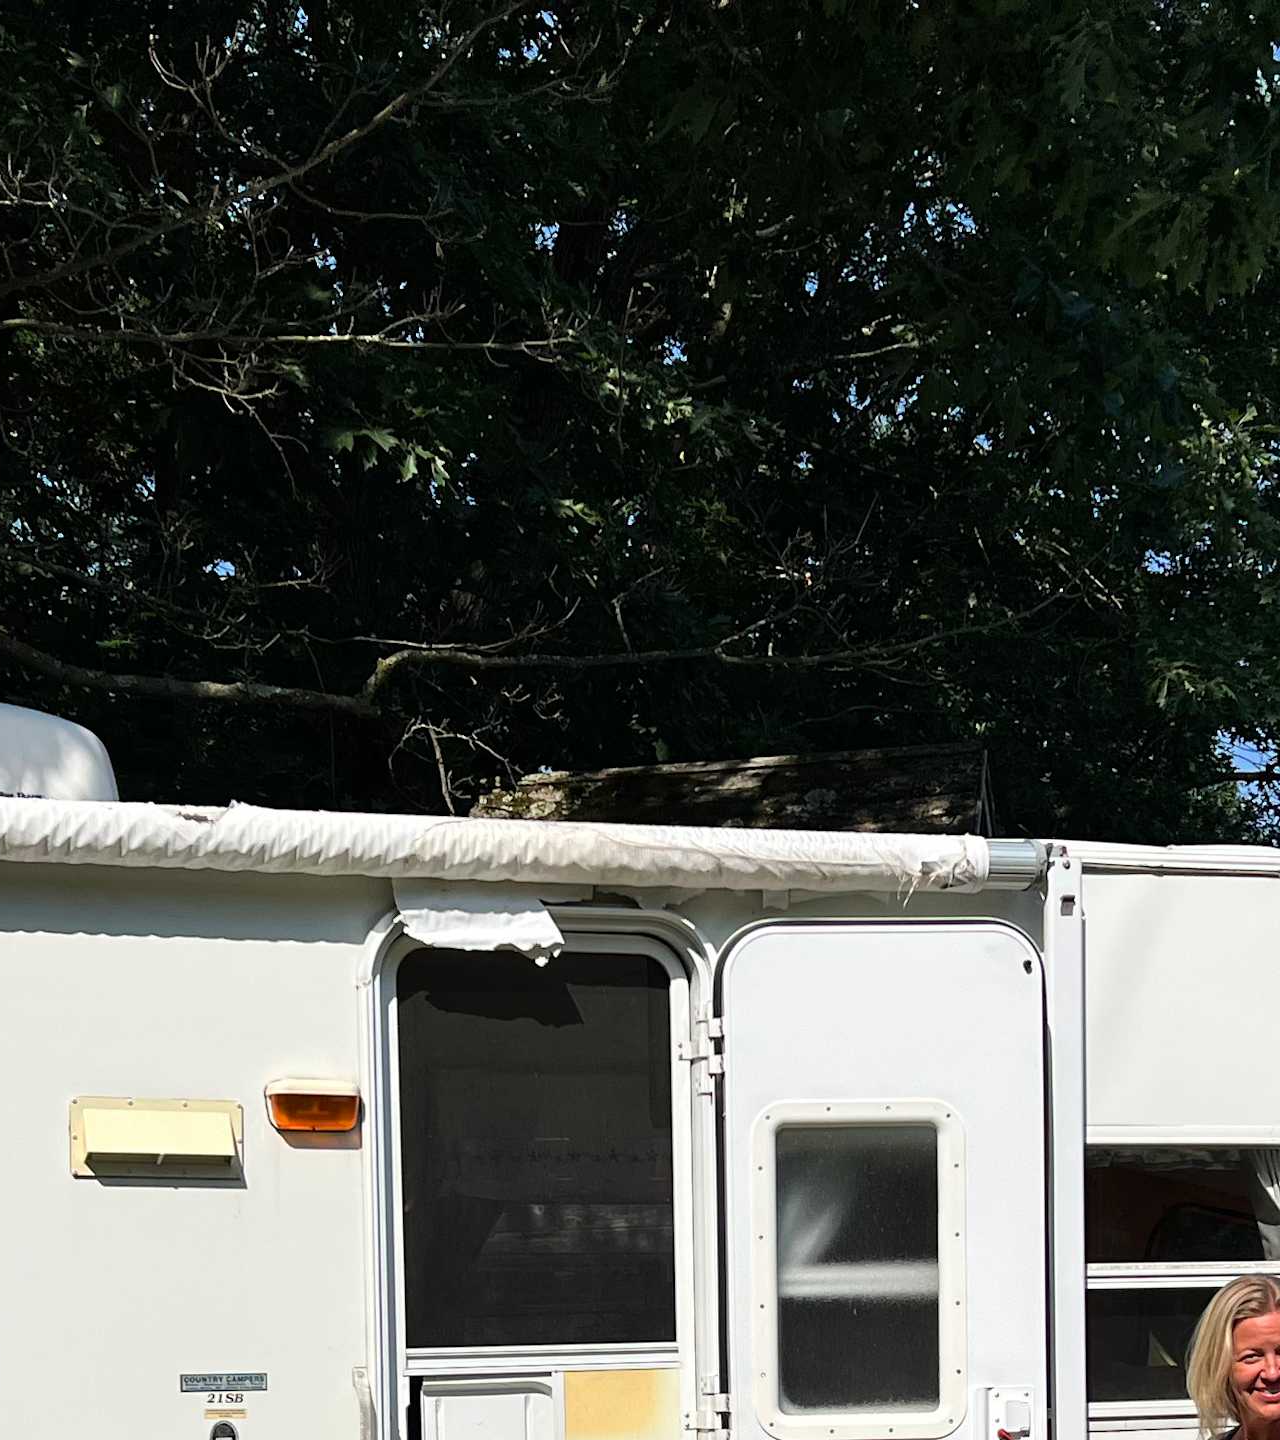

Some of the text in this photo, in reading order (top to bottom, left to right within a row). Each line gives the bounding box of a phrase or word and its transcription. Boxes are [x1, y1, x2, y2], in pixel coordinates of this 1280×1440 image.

[183, 1375, 265, 1384] COUNTRY CAMPERS
[207, 1393, 244, 1403] 21SB
